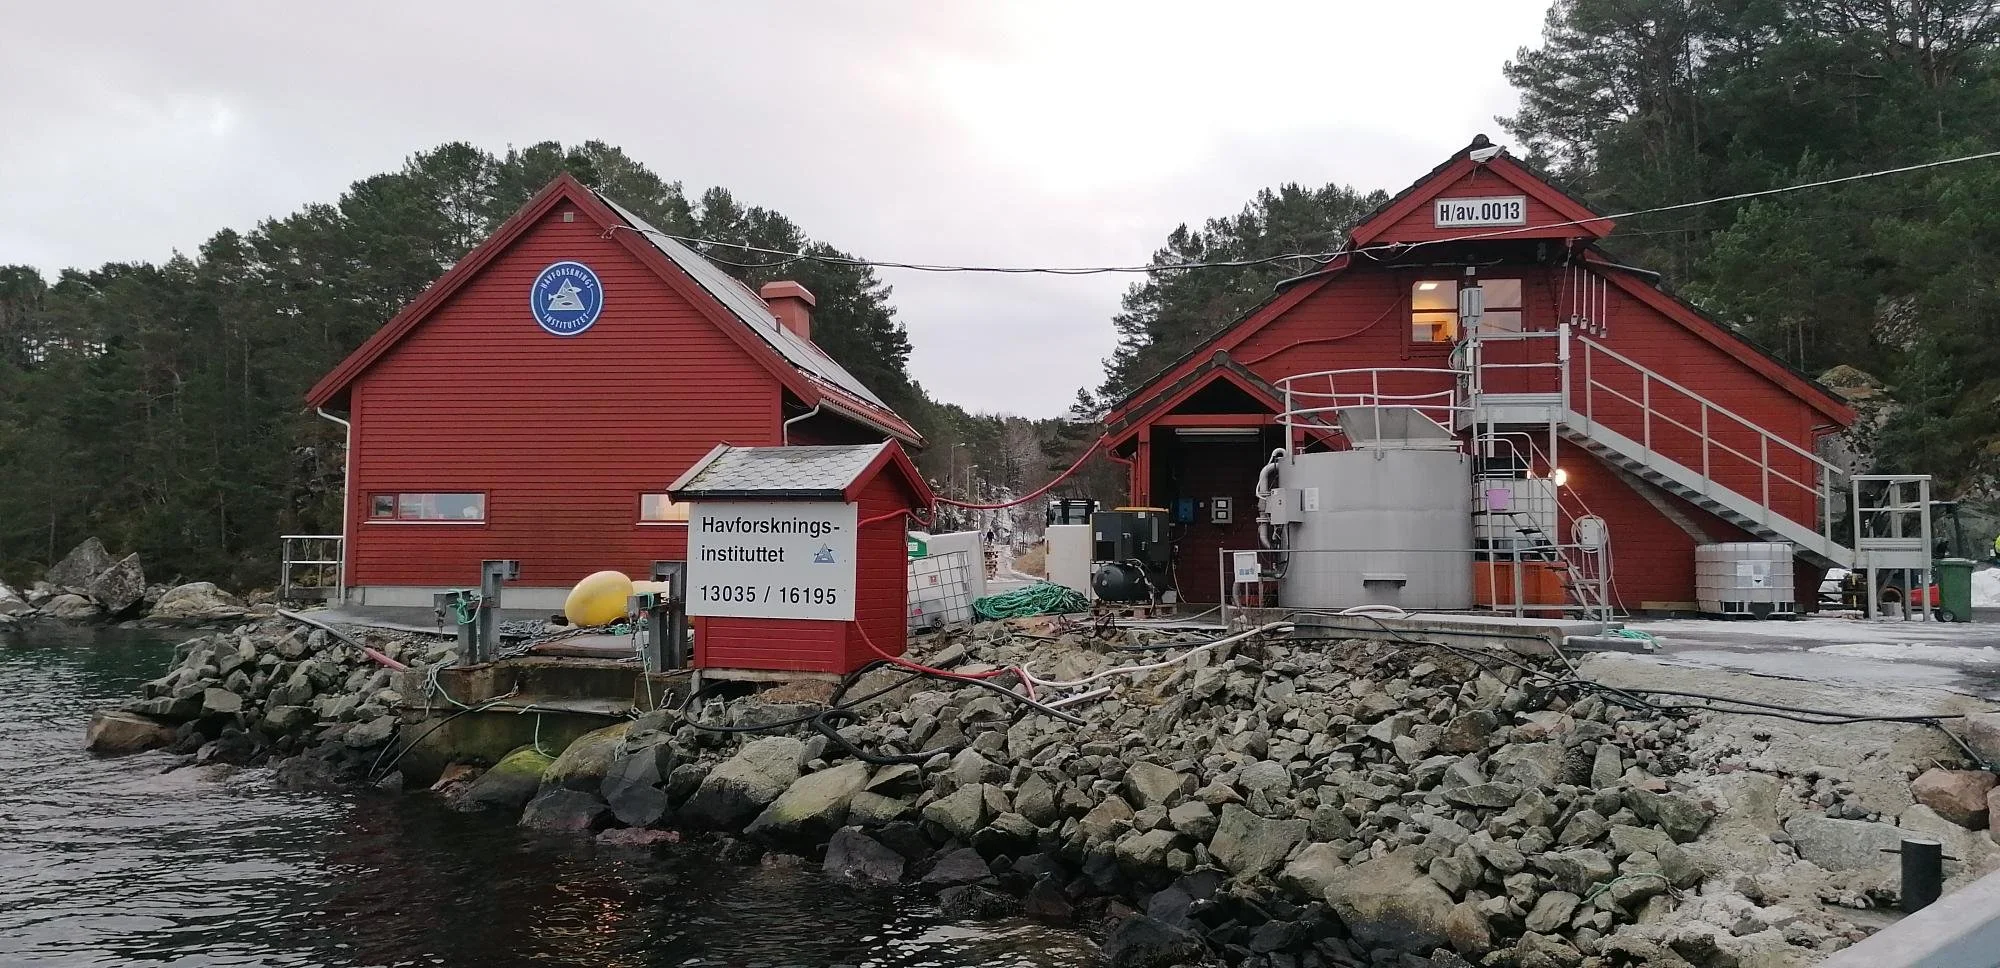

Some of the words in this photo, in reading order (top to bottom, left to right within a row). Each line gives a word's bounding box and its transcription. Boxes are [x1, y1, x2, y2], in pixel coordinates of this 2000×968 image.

[1440, 202, 1520, 222] H/av.0013
[540, 267, 594, 289] HAVFORSKNINGS
[543, 312, 590, 329] INSTITUTTET
[702, 516, 840, 538] Havforsknings-
[701, 545, 785, 563] instituttet
[700, 585, 756, 602] 13035
[763, 585, 771, 603] /
[779, 586, 837, 605] 16195
